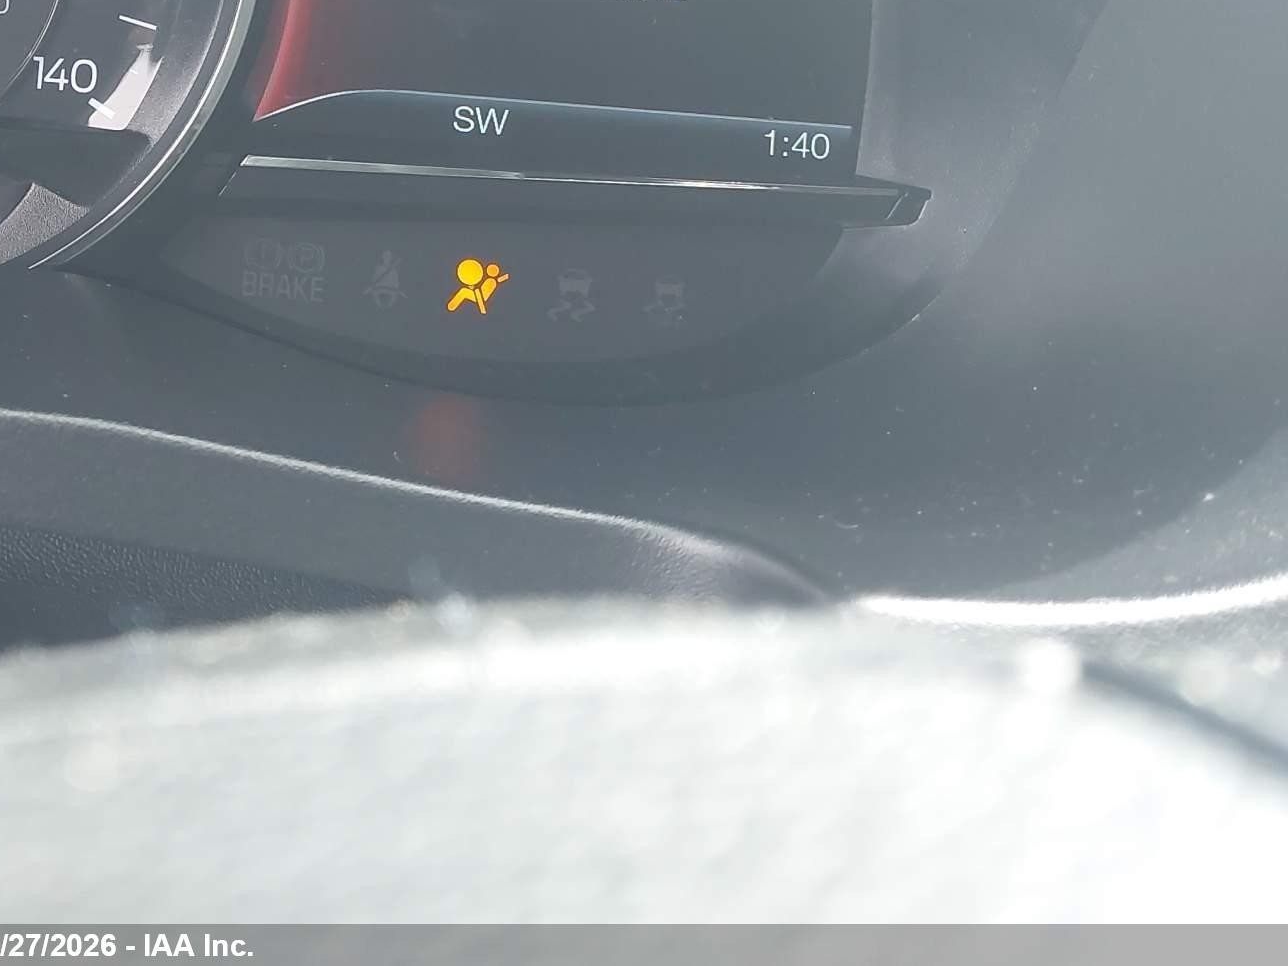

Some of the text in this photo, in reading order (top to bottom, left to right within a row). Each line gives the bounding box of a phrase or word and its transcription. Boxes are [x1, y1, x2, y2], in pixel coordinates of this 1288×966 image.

[34, 56, 98, 94] 140
[452, 105, 509, 137] SW
[764, 130, 830, 161] 1:40
[241, 271, 325, 304] BRAKE
